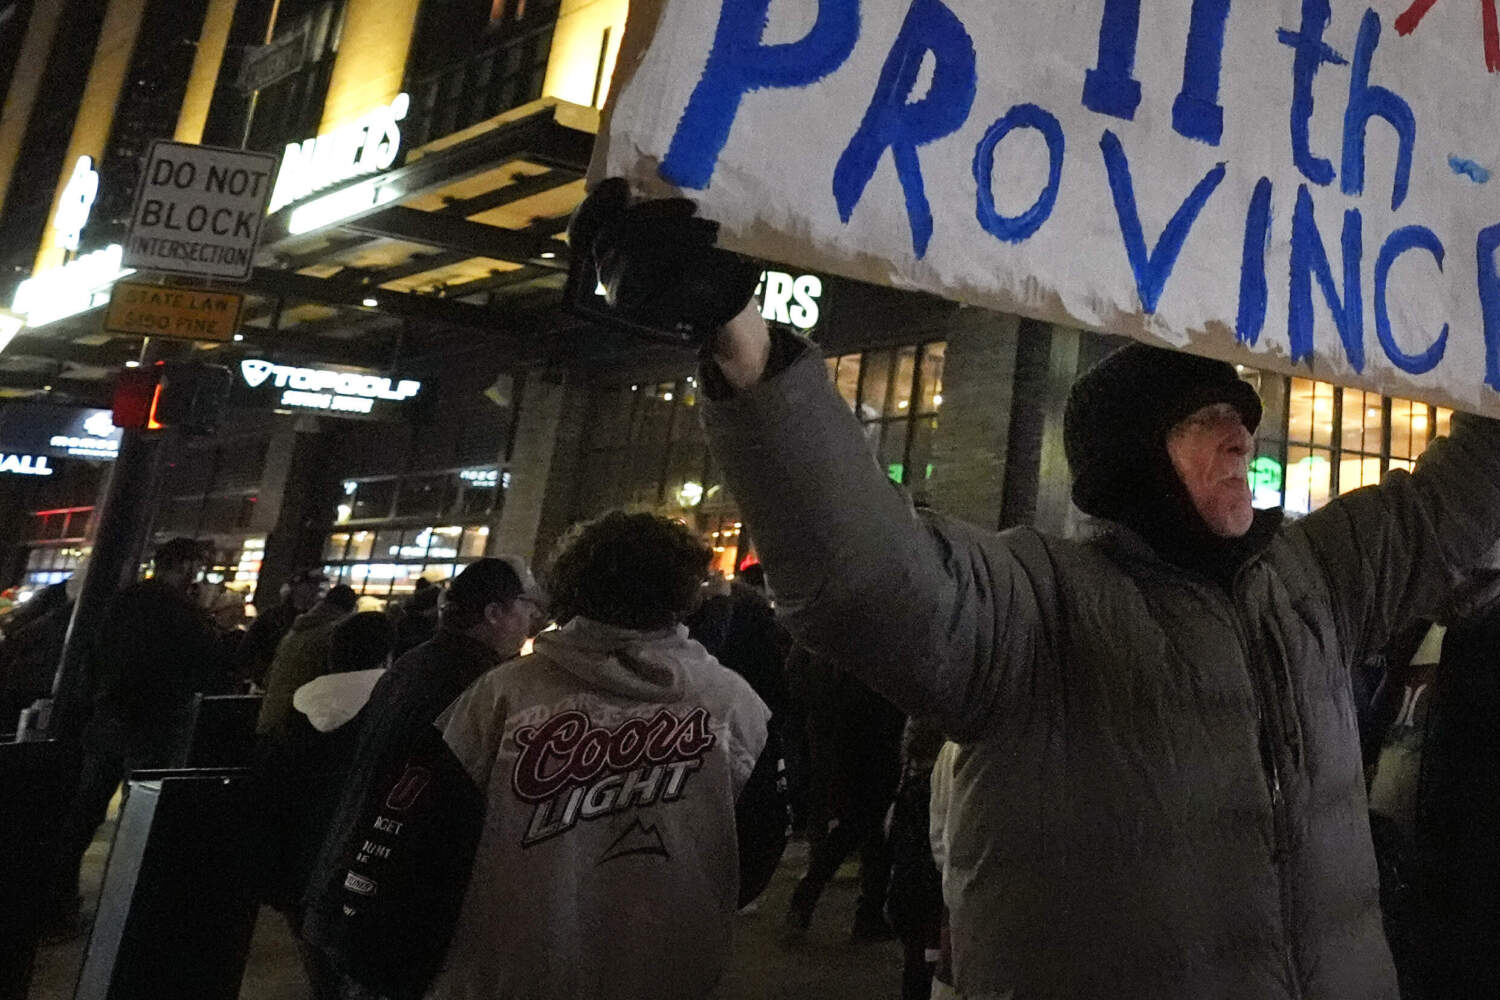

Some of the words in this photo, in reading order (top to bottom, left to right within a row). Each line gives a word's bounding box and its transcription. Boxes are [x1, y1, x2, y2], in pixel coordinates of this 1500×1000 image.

[151, 158, 197, 190] DO
[205, 165, 268, 198] NOT
[140, 199, 256, 239] BLOCK
[130, 233, 250, 267] INTERSECTION
[125, 289, 184, 308] STATE
[189, 295, 230, 312] LAW
[272, 364, 421, 401] TOPGOLF
[511, 706, 717, 805] Coors
[520, 757, 703, 850] LIGHT
